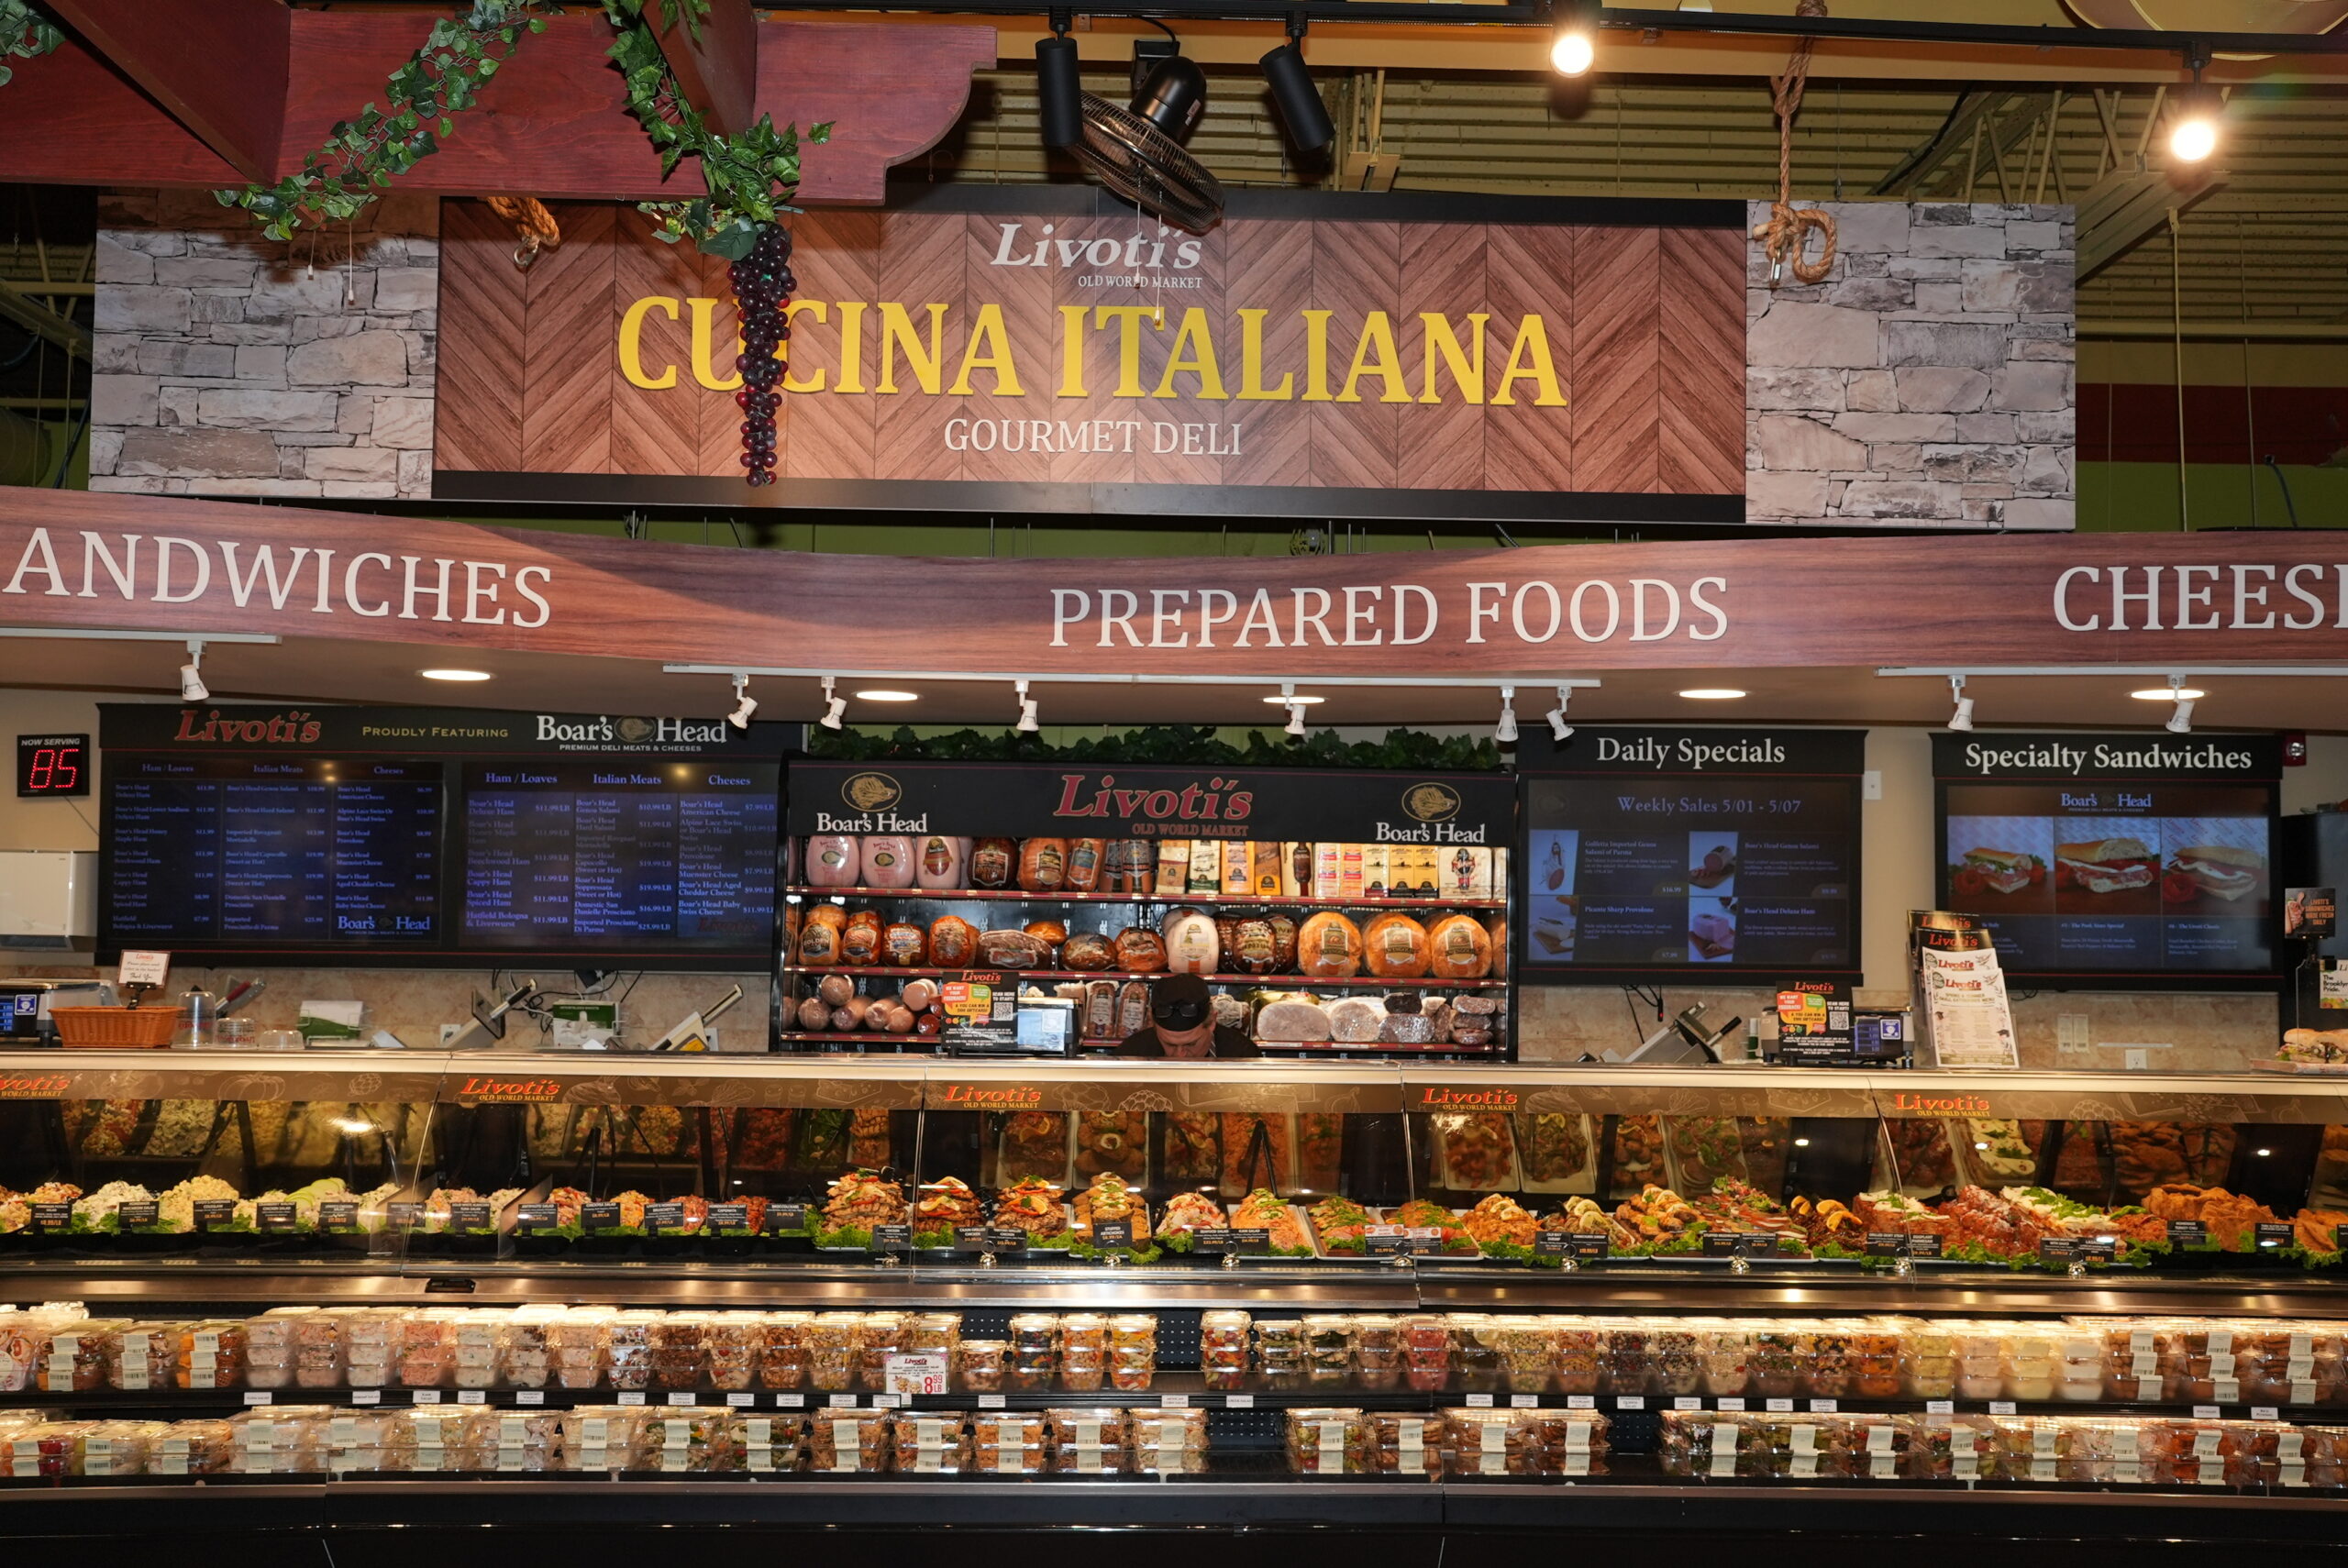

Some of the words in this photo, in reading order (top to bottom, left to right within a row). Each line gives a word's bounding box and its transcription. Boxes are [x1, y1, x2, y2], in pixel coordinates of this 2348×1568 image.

[991, 223, 1202, 269] Livoti's
[1078, 275, 1103, 287] OLD
[1106, 275, 1148, 288] WORD
[1152, 276, 1202, 289] MARKET
[618, 295, 1025, 397] CUCINA
[1057, 304, 1567, 407] ITALIANA
[944, 418, 1141, 454] GOURMET
[1152, 421, 1242, 456] DELI
[3, 527, 551, 629] ANDWICHES
[1048, 584, 1438, 649] PREPARED
[1467, 576, 1729, 644] FOODS
[174, 710, 322, 744] Livoti's
[537, 715, 613, 741] Boar's
[655, 718, 727, 745] Head
[1597, 737, 1669, 769] Daily
[1678, 738, 1786, 769] Specials
[1966, 744, 2088, 775] Specialty
[2094, 745, 2253, 769] Sandwiches
[29, 748, 80, 790] 85
[254, 765, 279, 773] Italian
[281, 765, 304, 774] Meats
[374, 767, 404, 775] Cheeses
[485, 773, 512, 783] Ham
[521, 773, 558, 784] Loaves
[593, 774, 627, 784] Italian
[631, 775, 661, 785] Meats
[708, 775, 751, 786] Cheeses
[1053, 775, 1254, 819] Livoti's
[2061, 792, 2098, 808] Boar's
[2118, 793, 2153, 808] Head
[681, 808, 714, 816] American
[716, 808, 741, 816] Cheese
[1618, 796, 1676, 816] Weekly
[1679, 798, 1718, 813] Sales
[1722, 799, 1754, 814] 5/01
[1769, 800, 1802, 815] 5/07
[816, 812, 872, 833] Boar's
[877, 813, 927, 833] Head
[1132, 823, 1156, 834] OLD
[1159, 824, 1199, 835] WORLD
[1202, 825, 1249, 837] MARKET
[1376, 823, 1429, 843] Boar's
[1434, 824, 1486, 844] Head
[679, 881, 702, 889] Boar's
[703, 881, 721, 889] Head
[723, 881, 741, 890] Aged
[493, 890, 512, 899] Head
[679, 900, 701, 909] Boar's
[703, 900, 721, 909] Head
[723, 900, 741, 910] Baby
[699, 908, 724, 916] Cheese
[338, 915, 375, 930] Boar's
[396, 916, 432, 931] Head
[1938, 959, 1975, 968] Livoti's
[961, 970, 1002, 982] Livoti's
[1945, 979, 1982, 988] Livoti's
[1795, 981, 1835, 991] Livoti's
[460, 1078, 560, 1096] Livoti's
[944, 1085, 1042, 1103] Livoti's
[1423, 1088, 1518, 1105] Livoti's
[1895, 1094, 1990, 1111] Livoti's
[925, 1376, 933, 1394] 8
[934, 1375, 943, 1384] 99
[934, 1385, 942, 1393] LB
